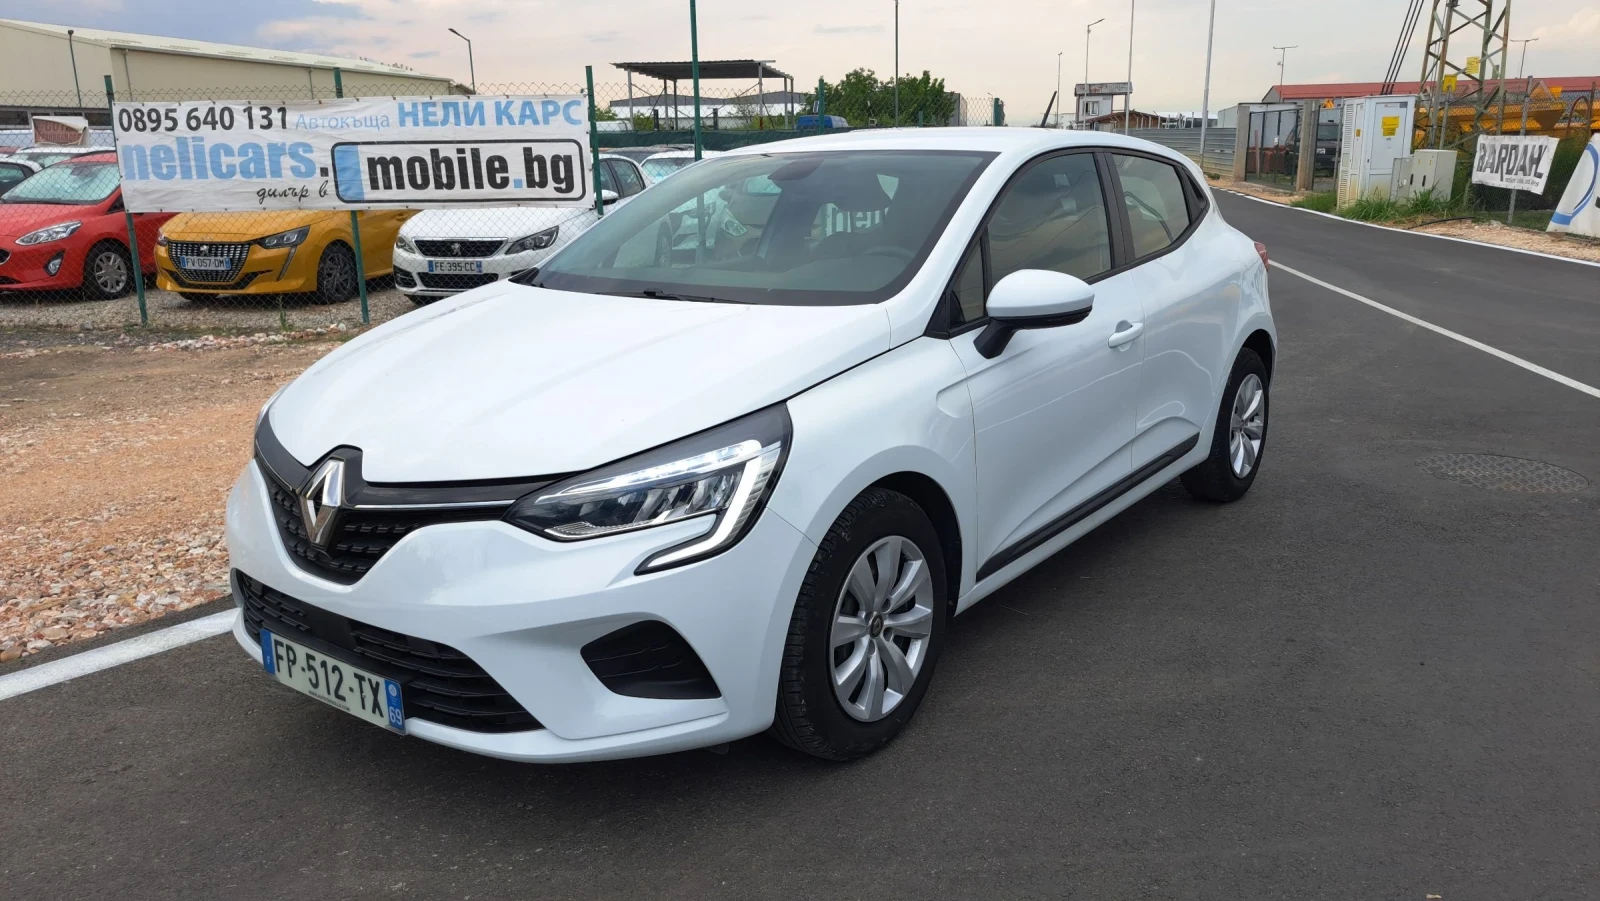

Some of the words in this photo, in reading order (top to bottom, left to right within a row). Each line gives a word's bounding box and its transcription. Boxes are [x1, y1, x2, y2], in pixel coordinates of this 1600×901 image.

[118, 108, 178, 132] 0895
[186, 106, 235, 131] 640
[243, 106, 288, 130] 131
[295, 113, 390, 131] Автокъща
[398, 101, 486, 127] НЕЛИ
[494, 99, 583, 126] КАРС
[366, 146, 575, 194] mobile.bg
[256, 185, 310, 205] дилър
[318, 180, 329, 198] в
[273, 639, 384, 718] FP-512-TX
[389, 706, 402, 725] 69
